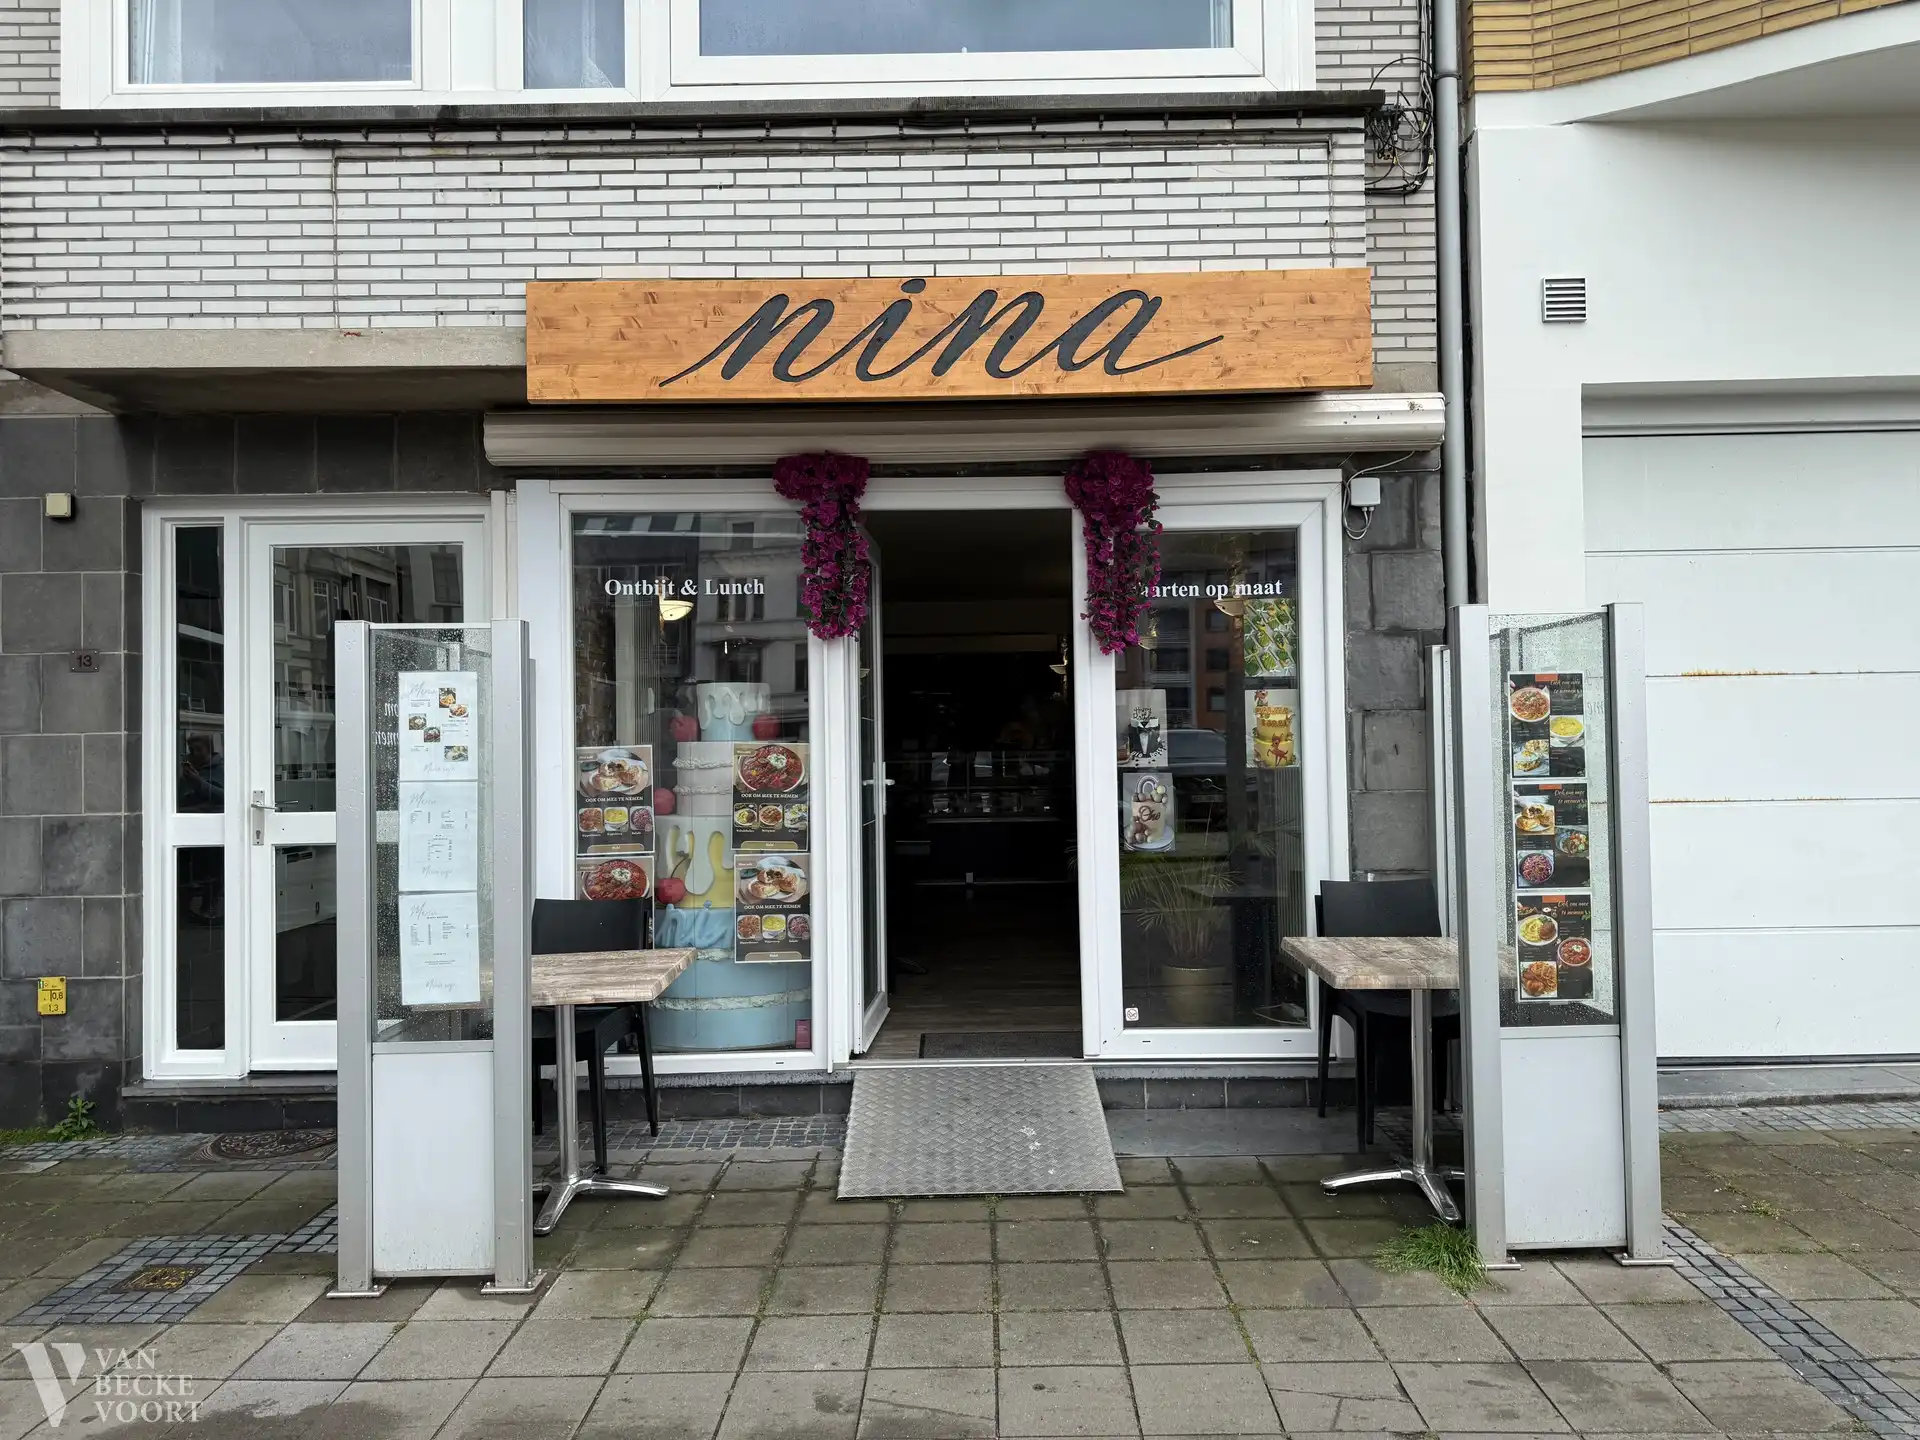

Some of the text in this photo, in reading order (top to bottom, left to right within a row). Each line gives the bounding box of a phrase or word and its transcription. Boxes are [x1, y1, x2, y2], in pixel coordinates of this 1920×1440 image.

[659, 278, 1224, 387] nina
[604, 579, 765, 597] Ontbijt & Lunch
[1139, 579, 1283, 600] aarten op maat
[76, 654, 92, 668] 13
